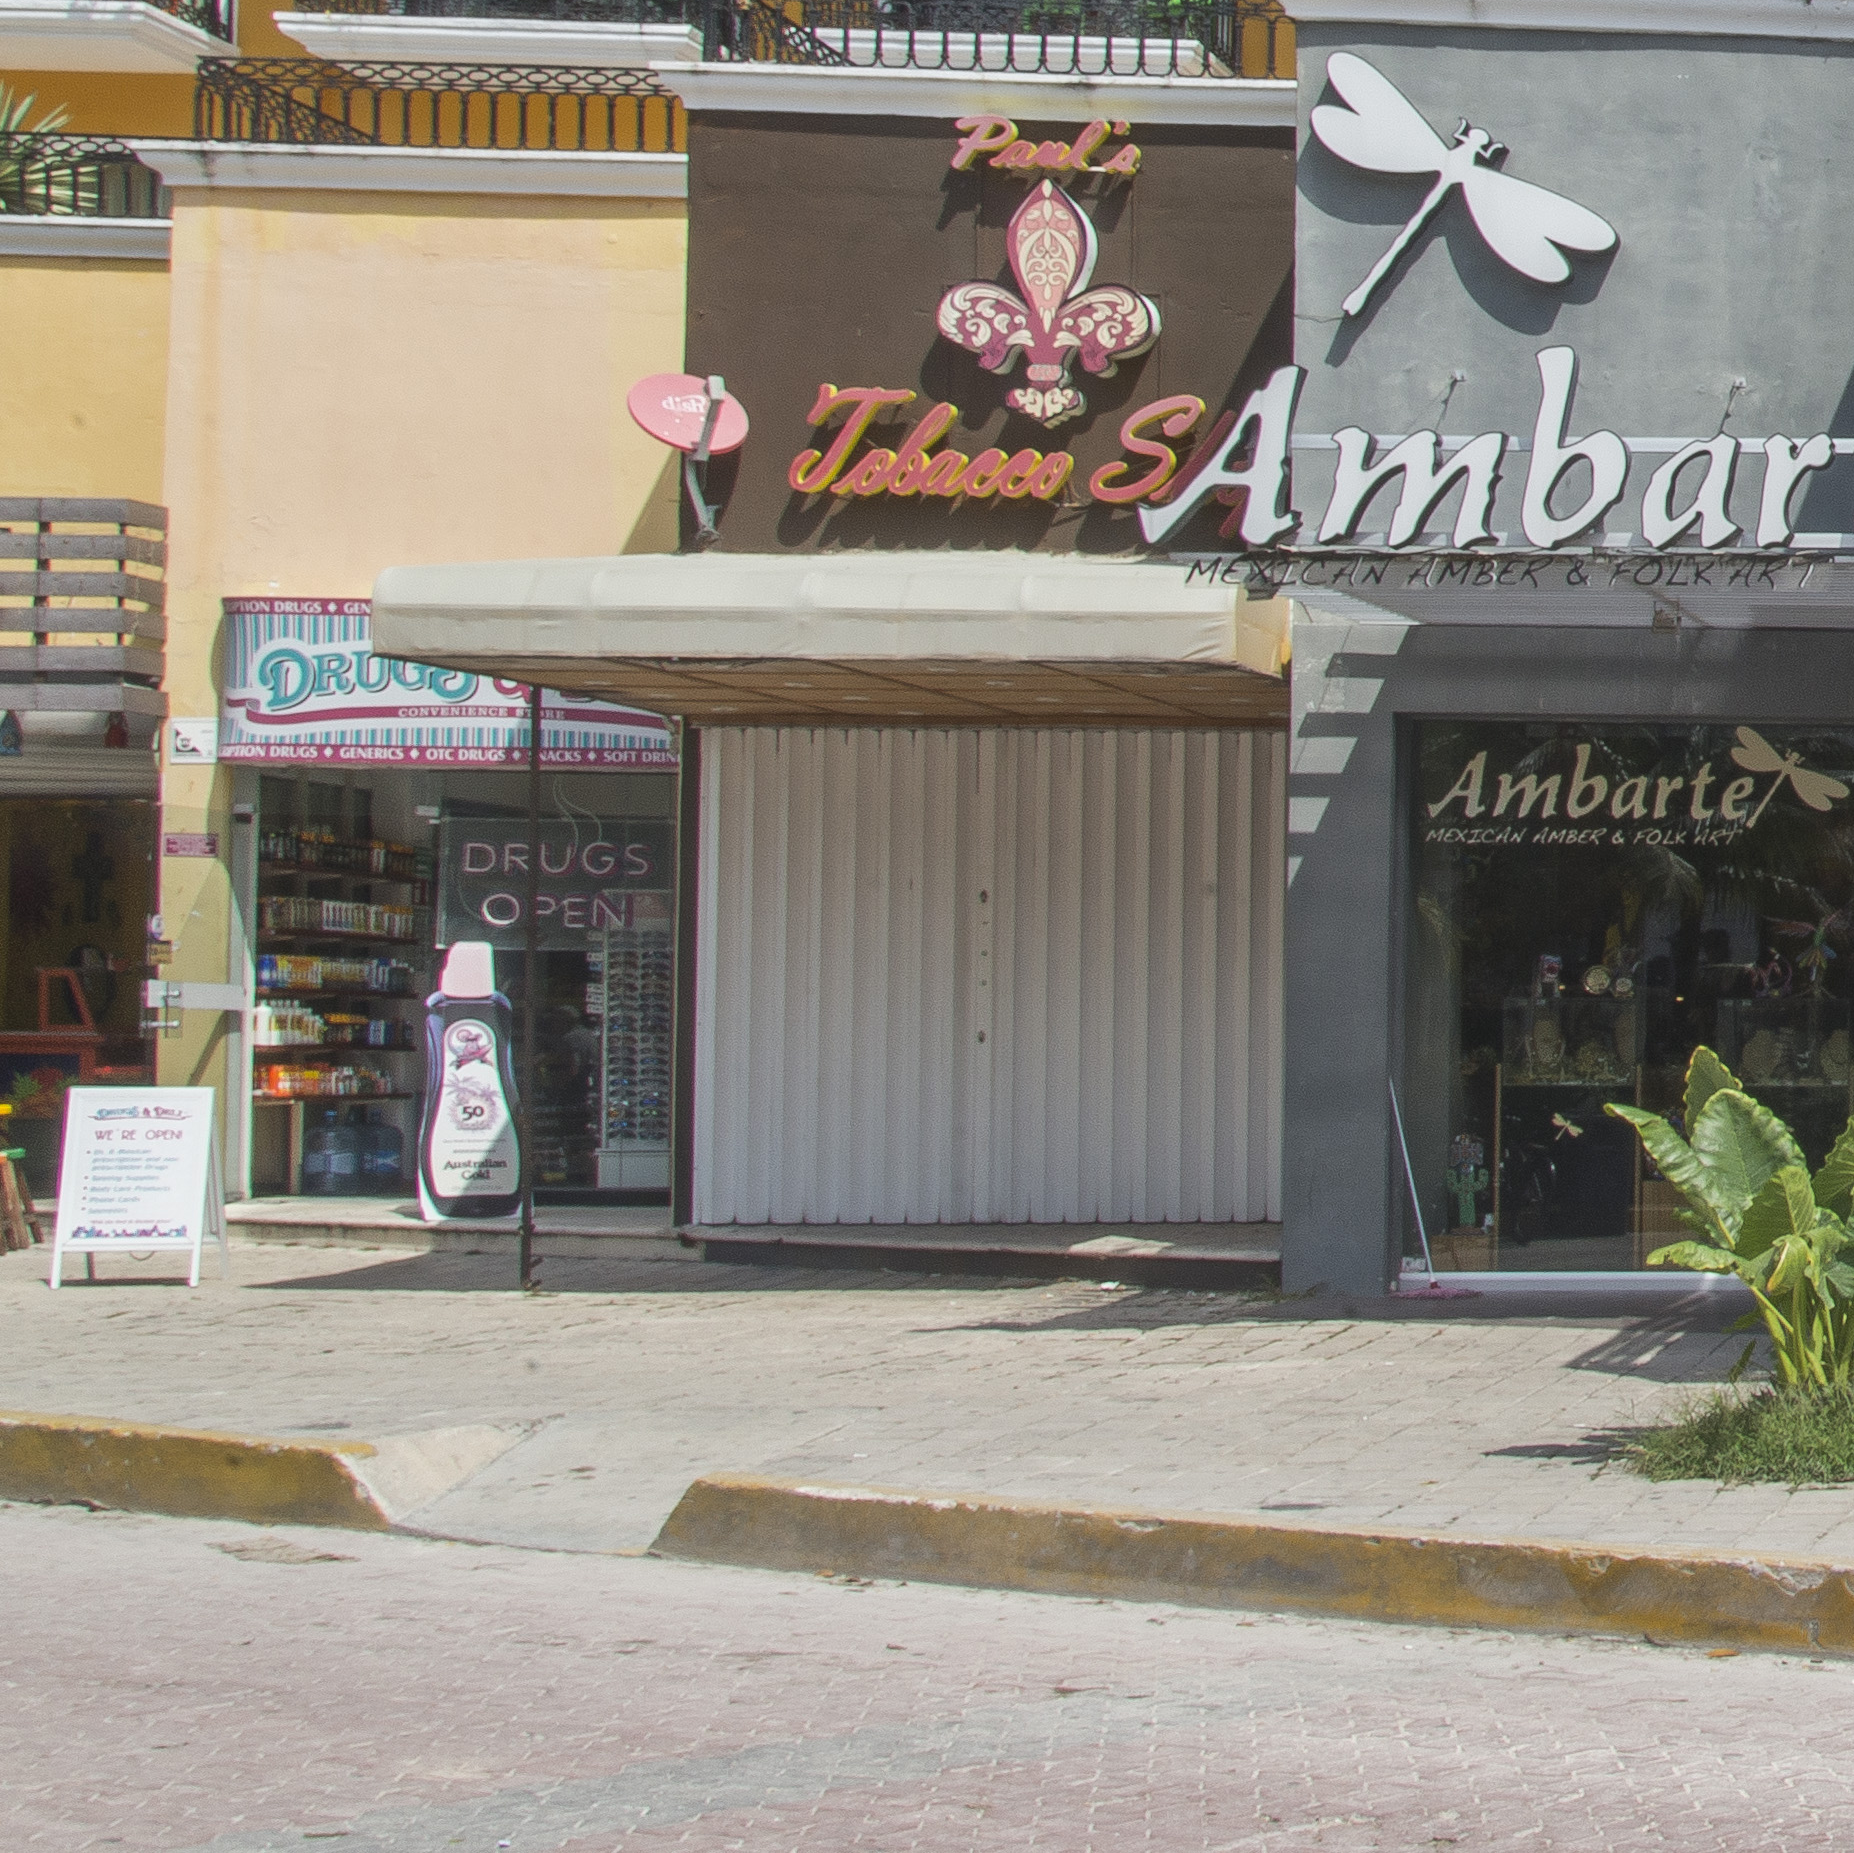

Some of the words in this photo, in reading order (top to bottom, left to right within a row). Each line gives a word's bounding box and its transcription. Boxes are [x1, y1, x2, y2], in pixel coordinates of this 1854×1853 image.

[954, 115, 1141, 175] Paul's
[789, 383, 1076, 500] Tobacco
[1185, 555, 1390, 589] MEXICAN
[1408, 555, 1554, 589] AMBER
[1566, 557, 1592, 587] &
[1611, 556, 1711, 589] FOLK
[1730, 556, 1815, 589] ART
[273, 601, 323, 614] DRUGS
[398, 707, 509, 718] CONVENIENCE
[269, 745, 319, 759] DRUGS
[339, 746, 404, 760] GENERICS
[425, 748, 455, 761] OTC
[458, 748, 506, 762] DRUGS
[528, 749, 582, 762] NACKS
[603, 750, 638, 763] SOFT
[641, 751, 680, 764] DRIN
[1428, 744, 1754, 820] Ambarte
[1425, 827, 1528, 846] MEXICAN
[1532, 827, 1604, 846] AMBER
[1612, 828, 1625, 845] &
[1634, 828, 1687, 846] FOLK
[1694, 827, 1744, 846] ART
[464, 842, 651, 876] DRUGS
[482, 893, 627, 929] OPEN
[461, 1105, 485, 1122] 50
[442, 1159, 508, 1170] Australian
